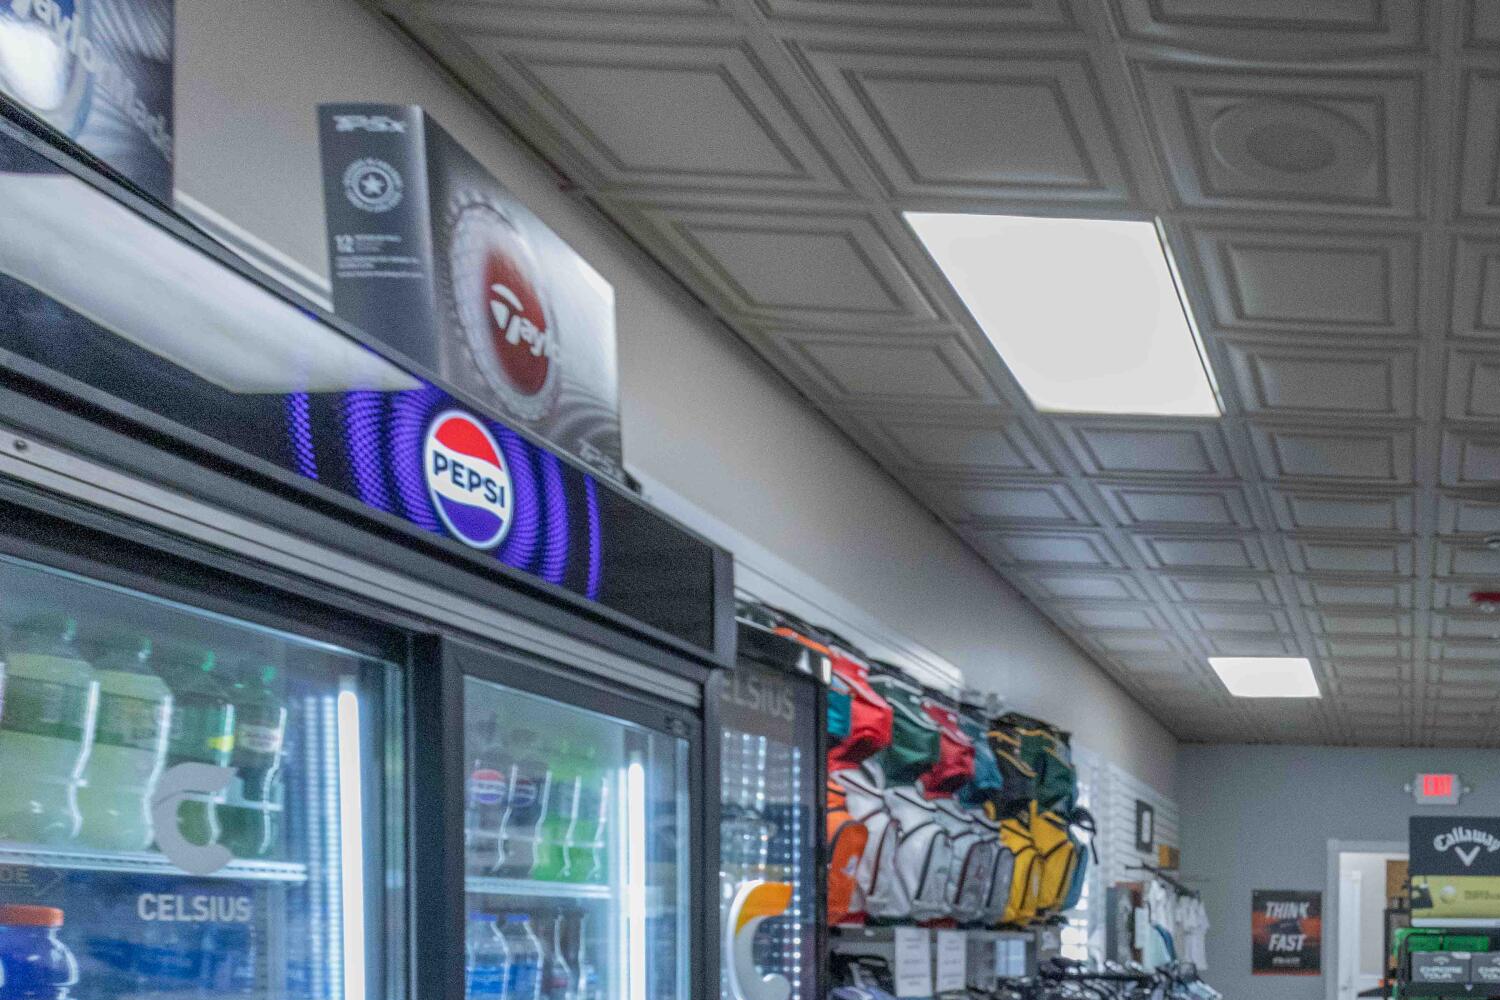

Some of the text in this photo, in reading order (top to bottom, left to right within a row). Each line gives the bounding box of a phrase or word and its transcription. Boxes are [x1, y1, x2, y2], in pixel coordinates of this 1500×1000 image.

[432, 450, 505, 508] PEPSI
[137, 893, 251, 922] CELSIUS
[1265, 901, 1310, 919] THINK
[1268, 934, 1307, 952] FAST
